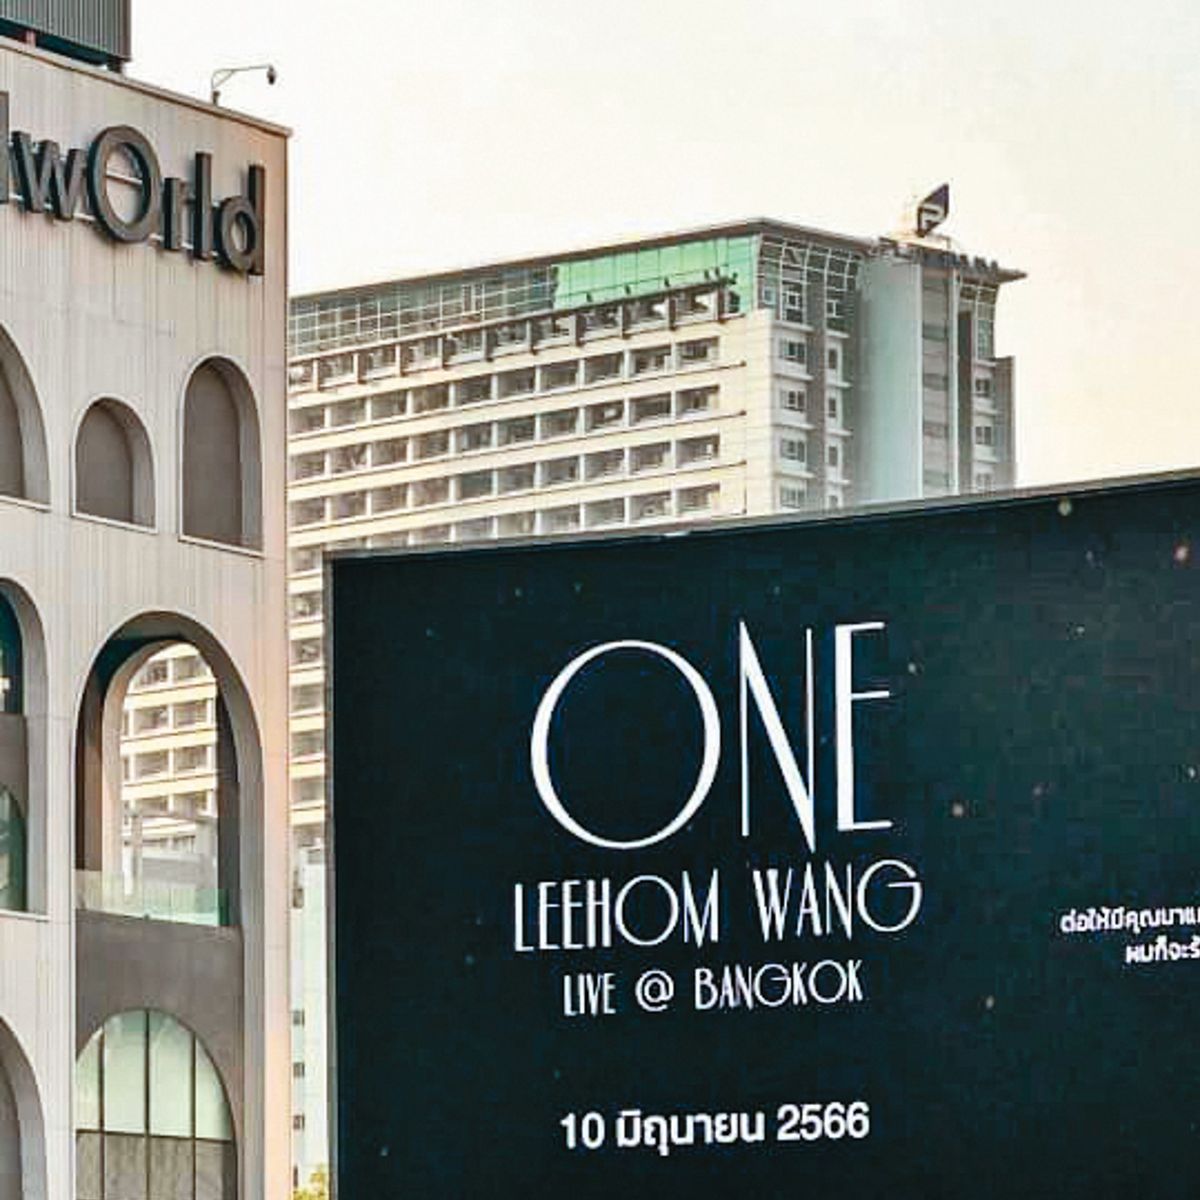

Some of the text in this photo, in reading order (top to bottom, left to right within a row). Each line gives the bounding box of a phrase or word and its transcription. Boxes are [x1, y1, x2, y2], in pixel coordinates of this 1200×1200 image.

[531, 621, 893, 853] ONE
[515, 859, 922, 952] LEEHOM WANG
[564, 959, 863, 1016] LIVE @ BANGKOK
[561, 1102, 870, 1156] 10 มิถุนายน 2566
